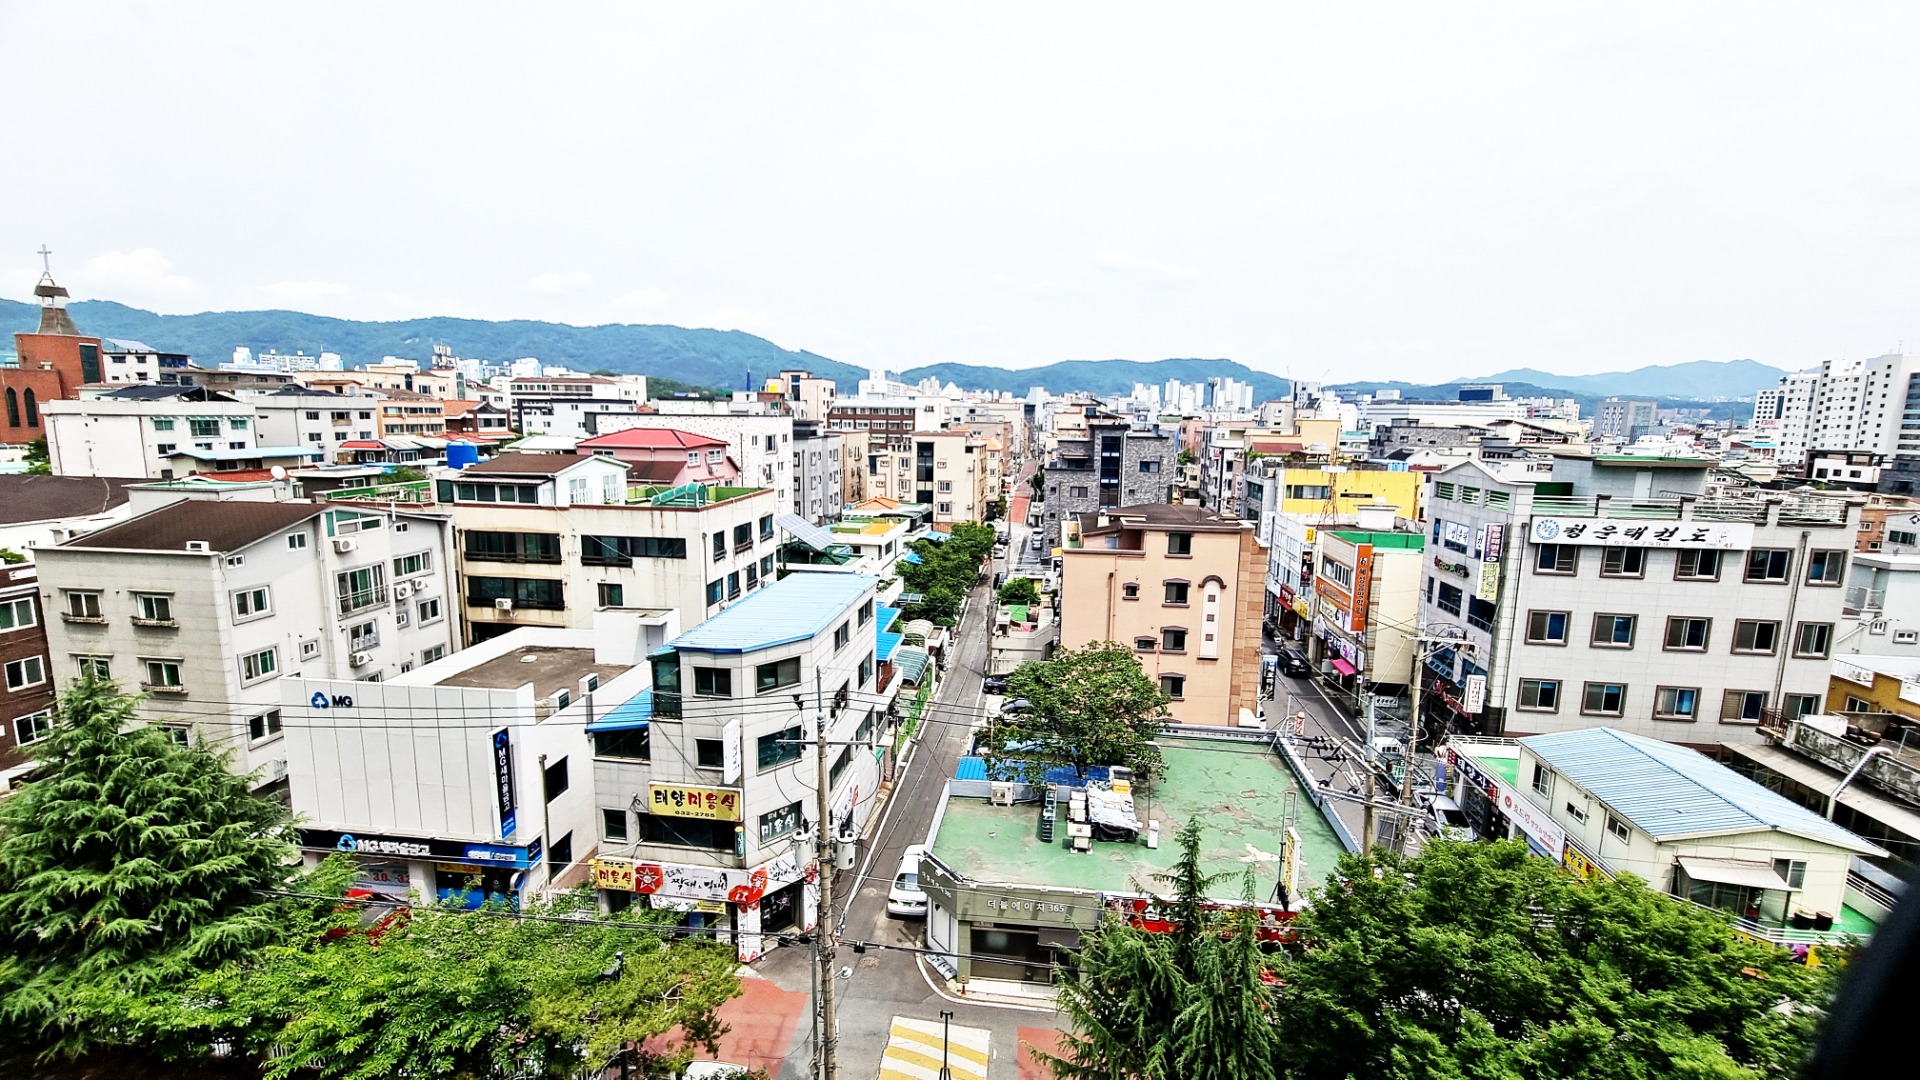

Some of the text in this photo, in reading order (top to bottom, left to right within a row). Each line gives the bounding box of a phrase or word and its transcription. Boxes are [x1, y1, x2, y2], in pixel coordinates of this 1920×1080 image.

[1563, 524, 1710, 543] 청운태권도
[331, 695, 353, 708] MG
[498, 747, 511, 812] MG새마을금고
[1457, 757, 1488, 789] 태양사
[761, 813, 795, 838] 미용실
[599, 869, 633, 885] 미용실
[987, 900, 1065, 913] 더블에이치 365
